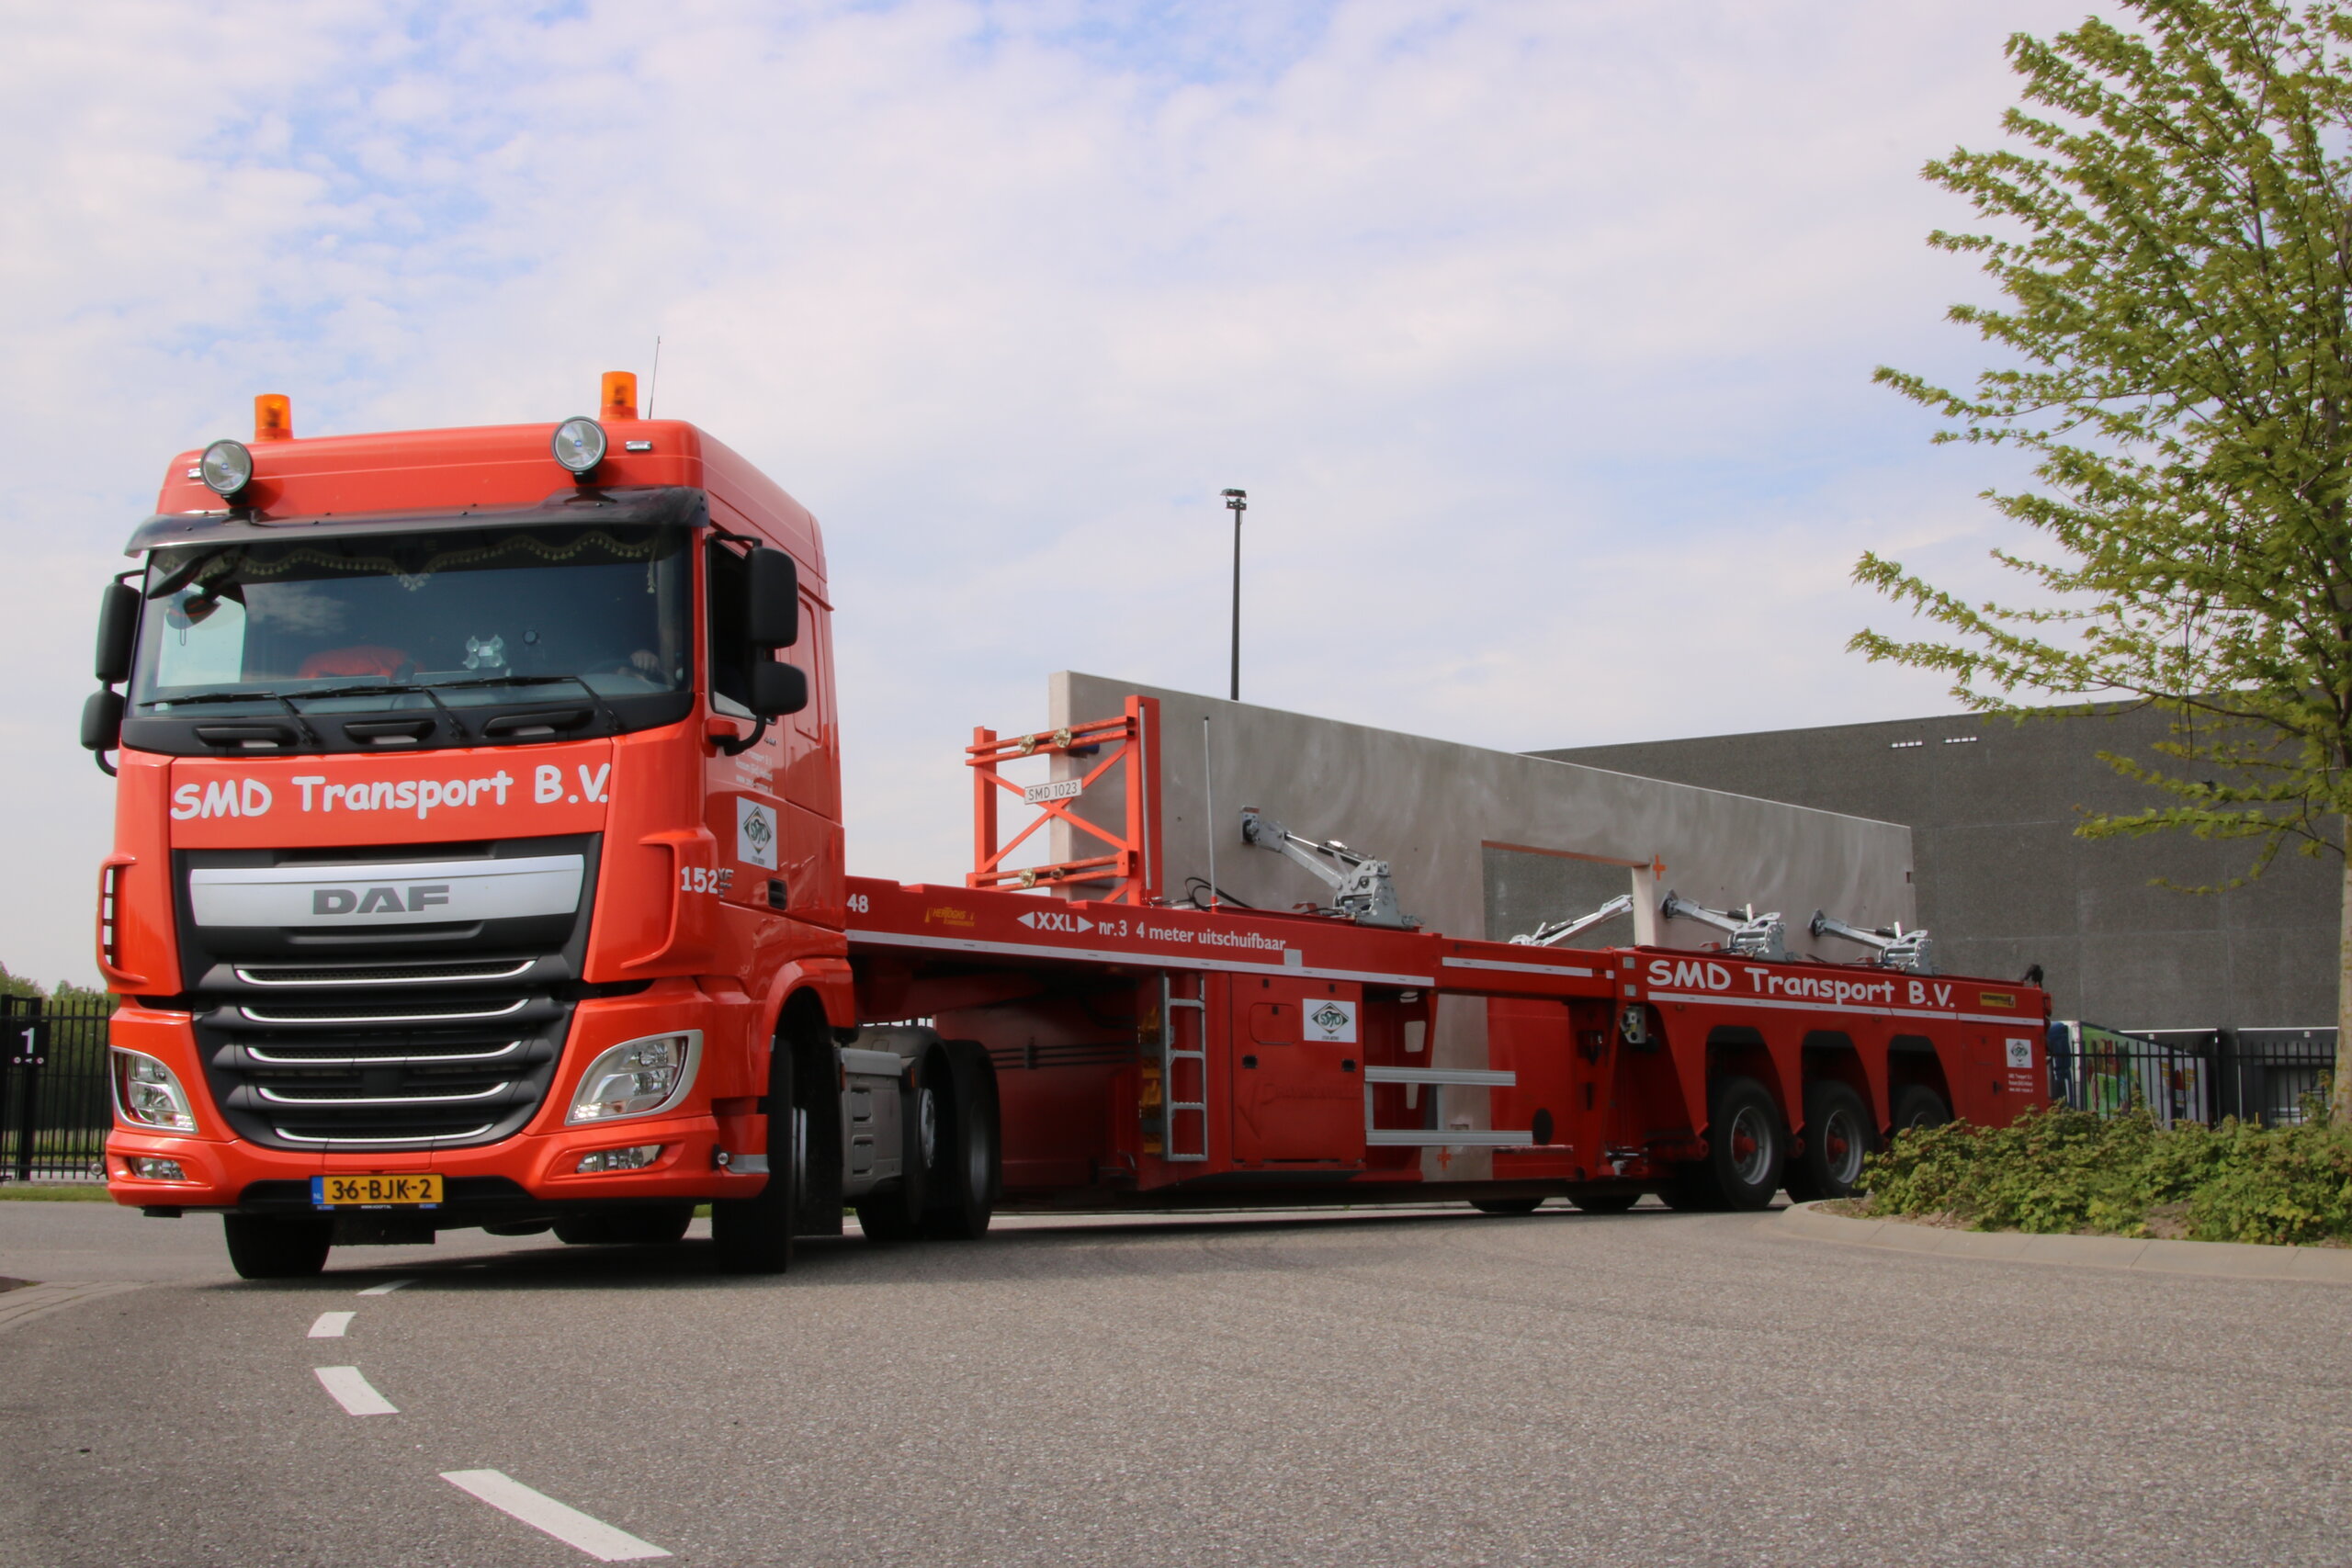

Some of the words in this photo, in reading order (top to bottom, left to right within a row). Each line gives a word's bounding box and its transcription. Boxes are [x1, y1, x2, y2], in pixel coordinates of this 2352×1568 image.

[171, 778, 272, 819] SMD
[291, 770, 514, 819] Transport
[534, 762, 611, 805] B.V.
[1028, 786, 1051, 801] SMD
[1054, 782, 1078, 797] 1023
[681, 865, 718, 894] 152
[312, 885, 449, 915] DAF
[846, 893, 869, 913] 48
[1036, 911, 1076, 932] XXL
[1136, 921, 1146, 938] 4
[1149, 926, 1194, 942] meter
[1198, 928, 1286, 951] uitschuifbaar
[1646, 959, 1732, 990] SMD
[1744, 967, 1895, 1005] Transport
[1908, 980, 1955, 1008] B.V.
[21, 1027, 35, 1055] 1
[332, 1179, 432, 1201] 36-BJK-2
